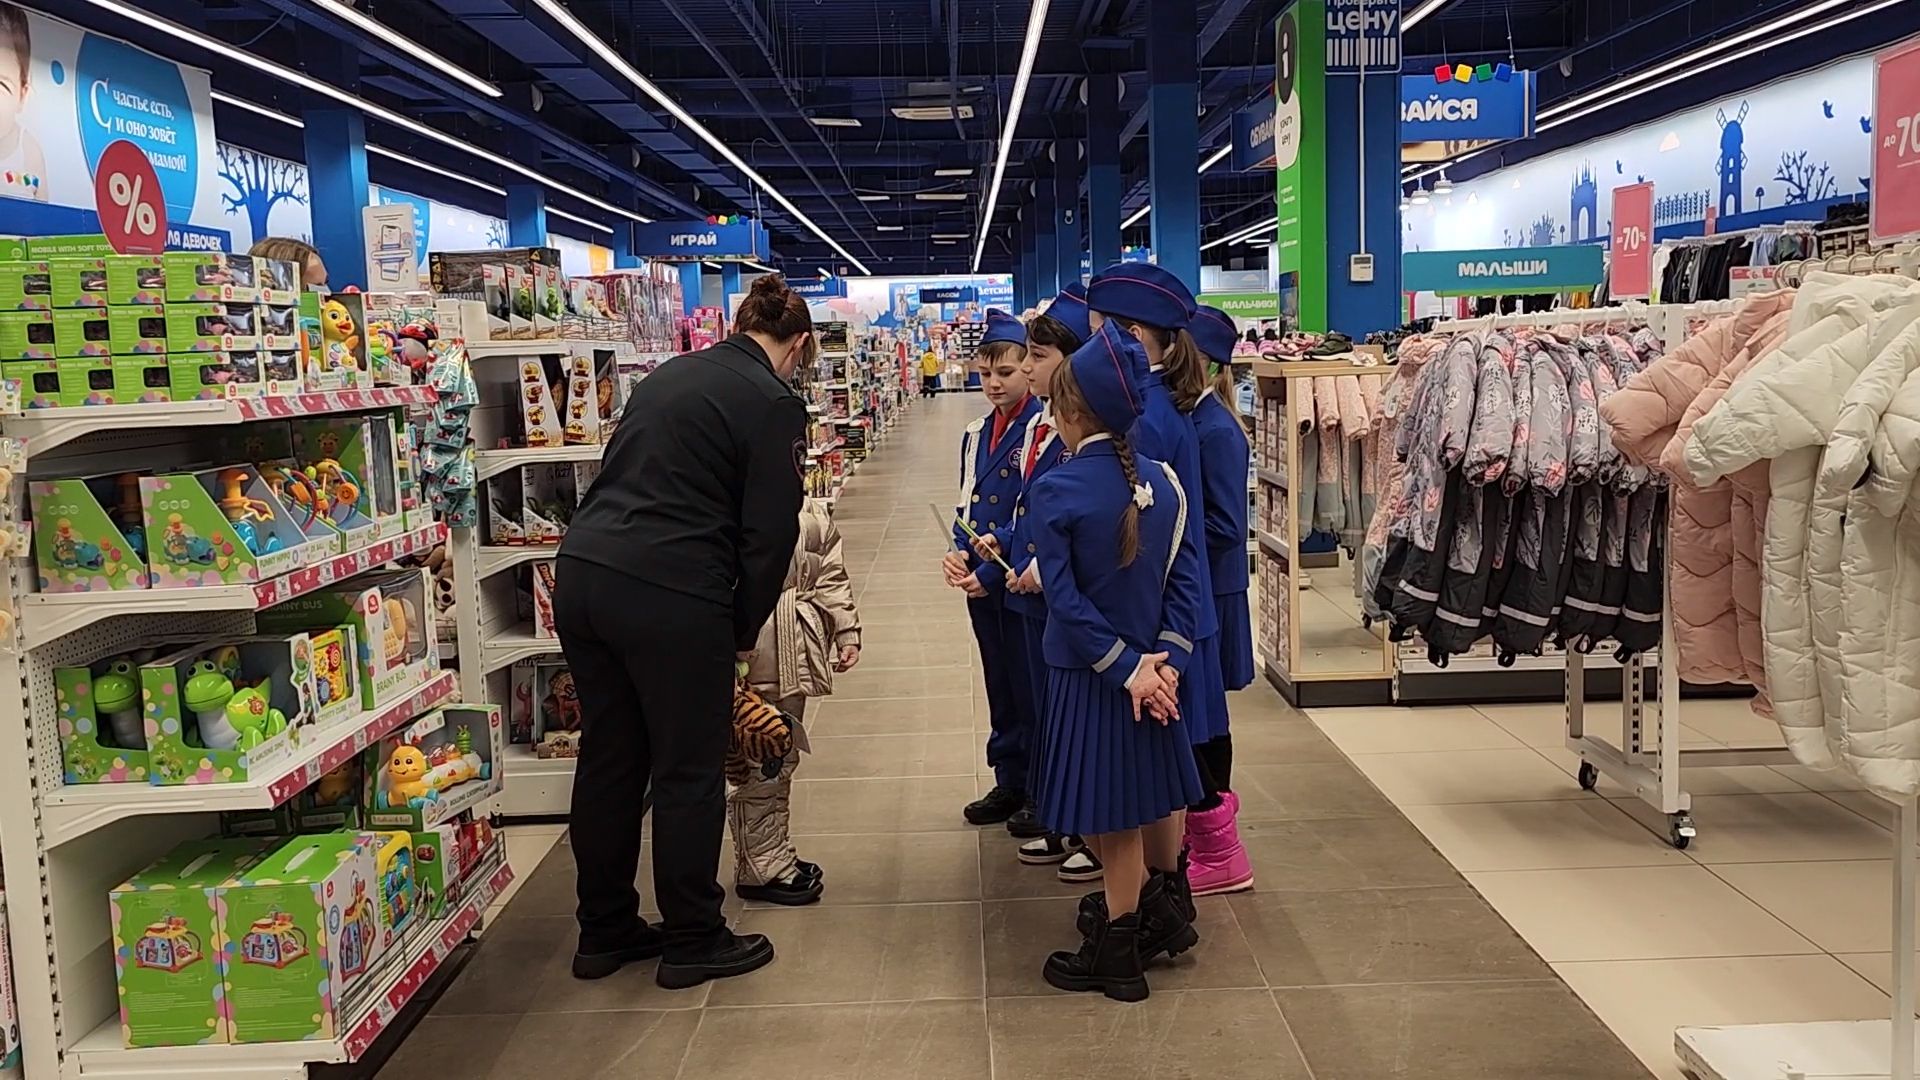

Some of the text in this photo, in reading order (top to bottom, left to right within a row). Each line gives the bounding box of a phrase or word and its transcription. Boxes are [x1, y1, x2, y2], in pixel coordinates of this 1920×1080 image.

[1326, 10, 1398, 36] цену
[126, 121, 148, 138] оно
[164, 229, 223, 252] ЛЯ ДЕВОЧЕК
[670, 231, 718, 247] ИГРАЙ
[1458, 259, 1548, 277] МАЛЫШИ
[1222, 299, 1277, 309] МАЛЬЧИКИ
